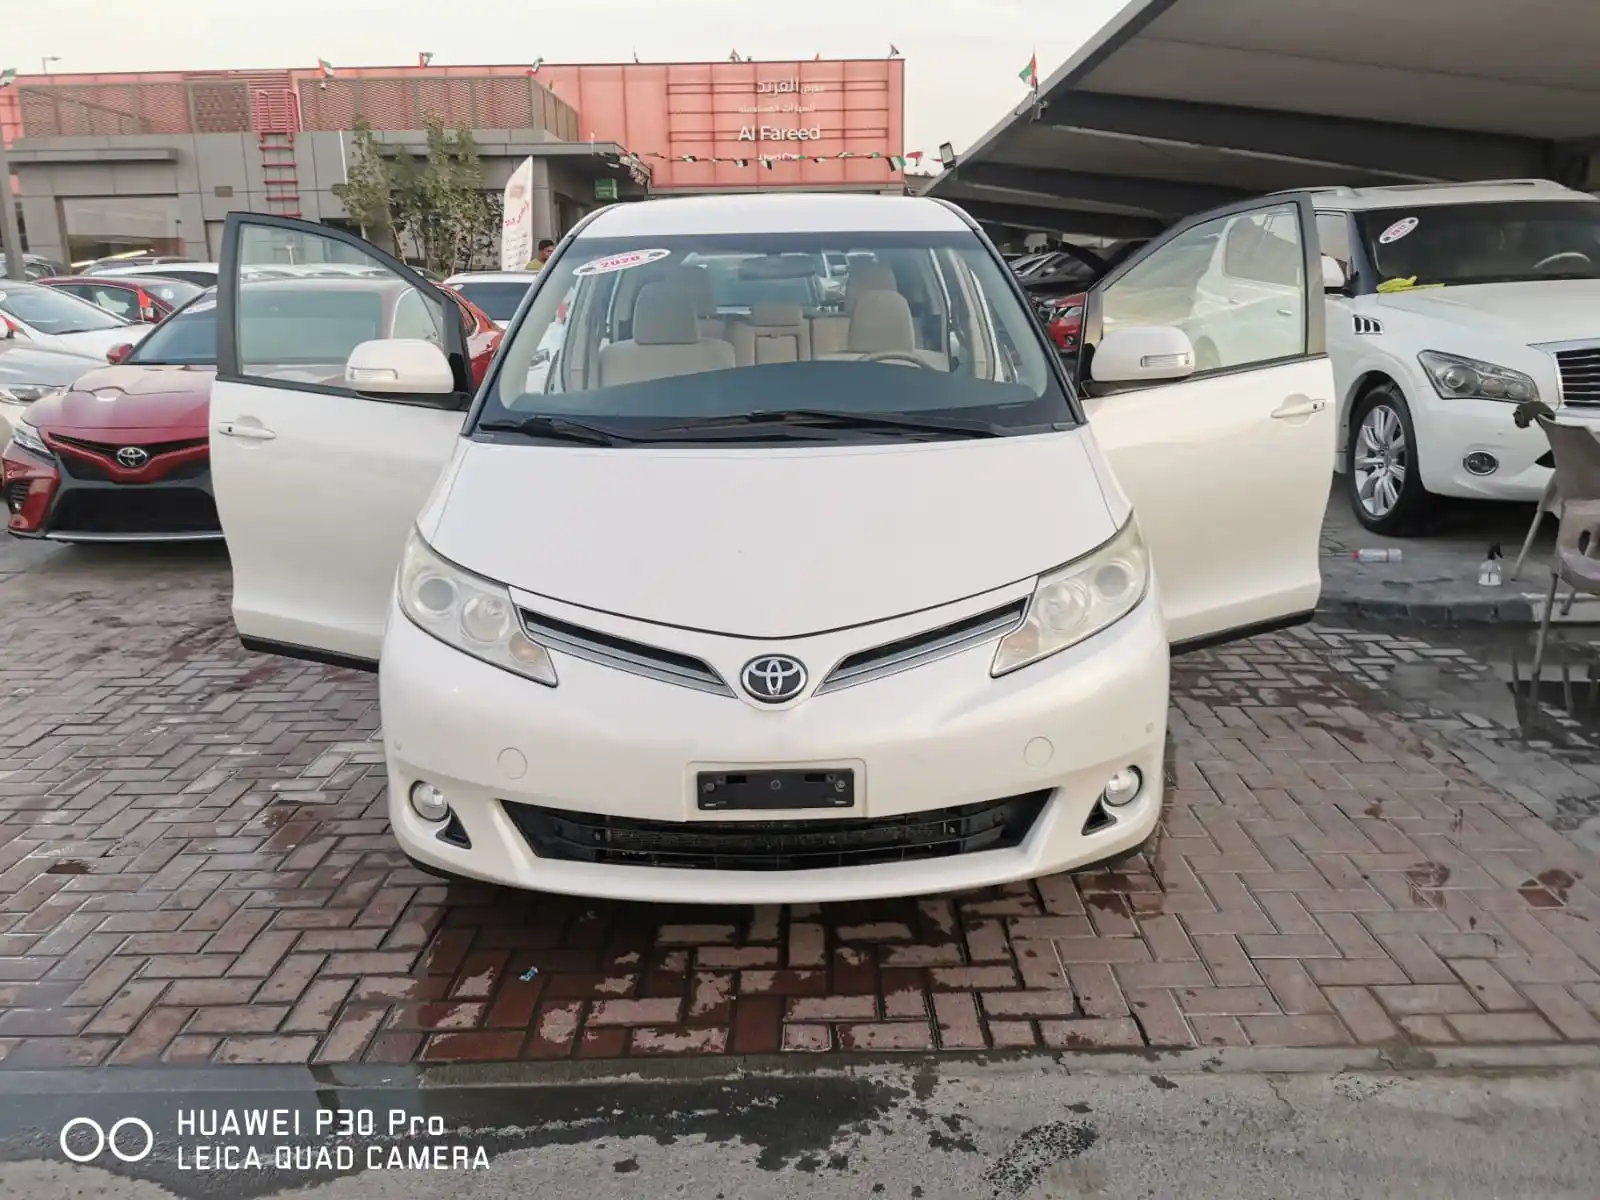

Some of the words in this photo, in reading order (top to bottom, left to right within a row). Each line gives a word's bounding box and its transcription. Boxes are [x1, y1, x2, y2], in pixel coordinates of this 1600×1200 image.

[757, 75, 799, 97] الفريد
[738, 124, 756, 141] Al
[760, 123, 821, 141] Fareed
[600, 255, 641, 268] 2020
